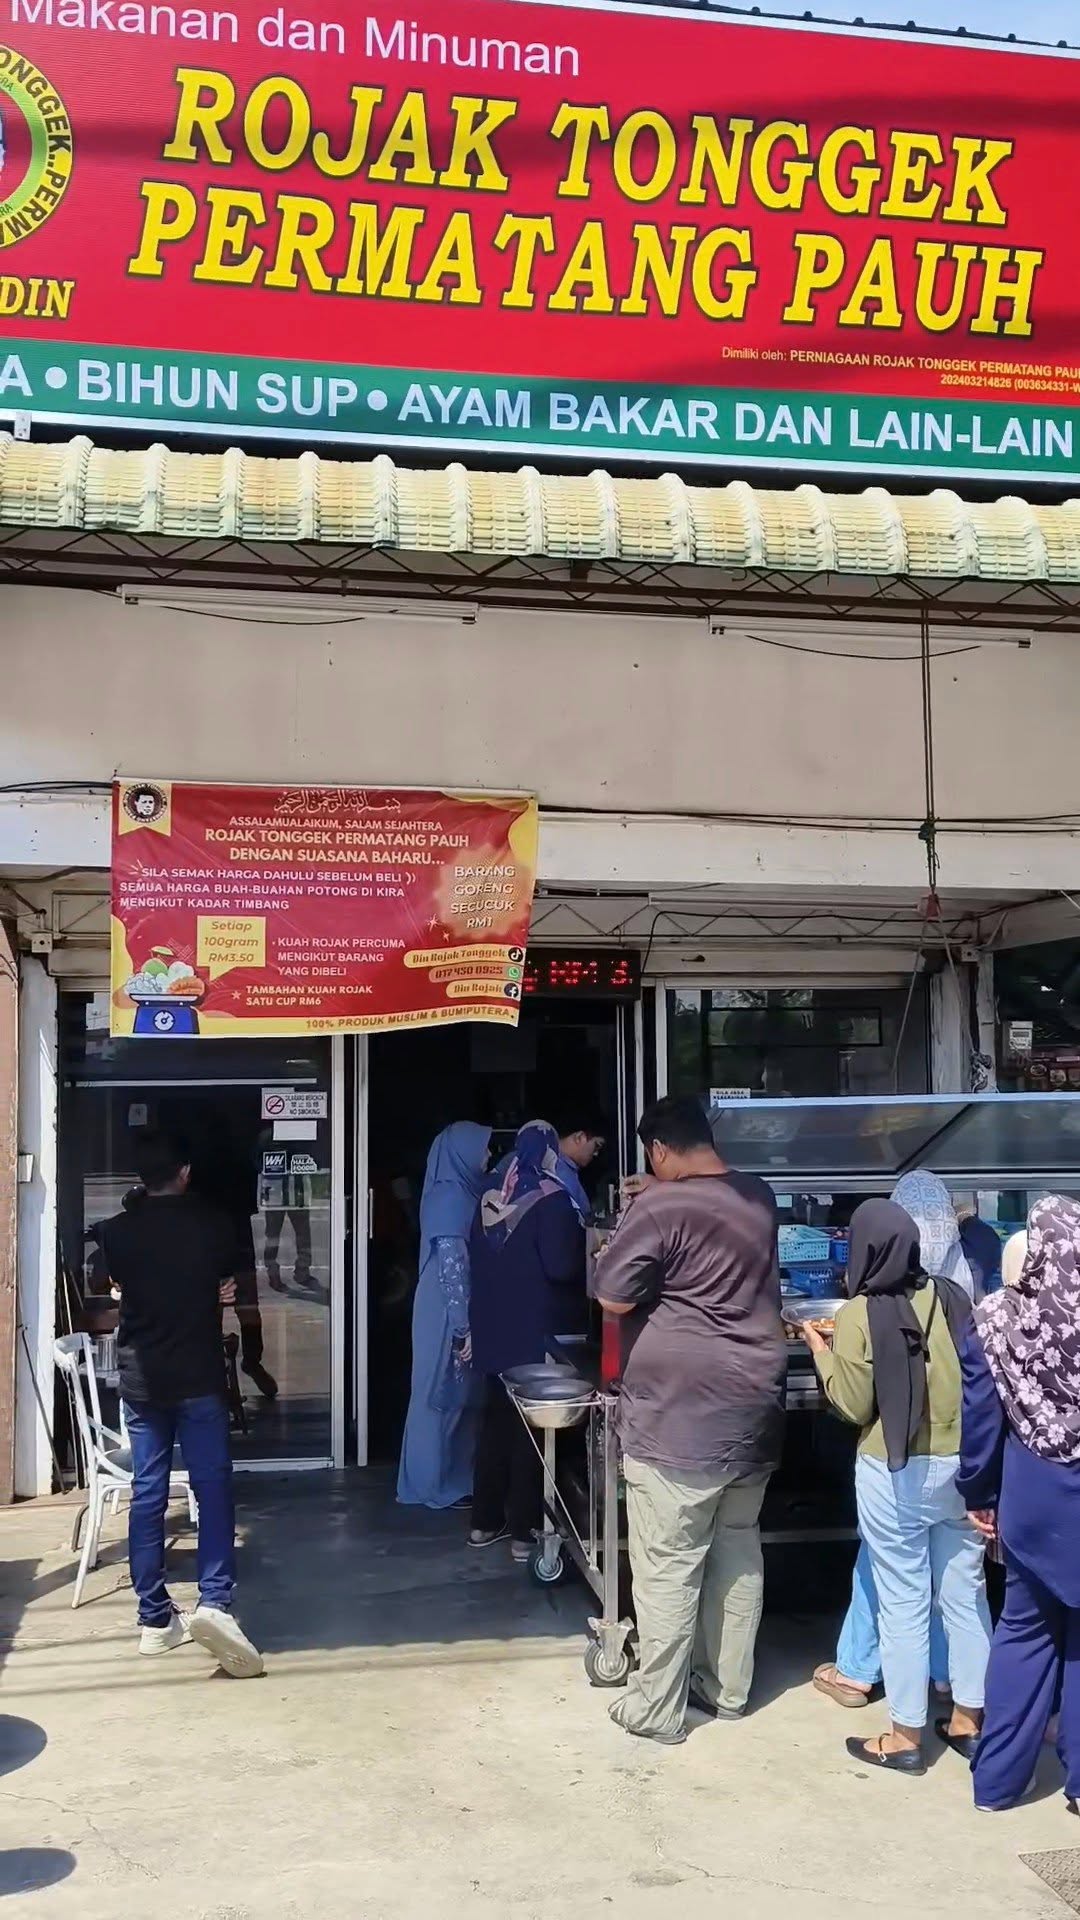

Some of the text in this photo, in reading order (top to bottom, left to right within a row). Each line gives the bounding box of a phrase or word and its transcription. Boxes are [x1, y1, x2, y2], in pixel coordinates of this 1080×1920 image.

[11, 0, 580, 76] Makanan dan Minuman
[163, 67, 1013, 225] ROJAK TONGGEK
[128, 182, 1042, 336] PERMATANG PAUH
[0, 276, 75, 318] DIN
[722, 346, 1080, 379] Dimiliki oleh: PERNIAGAAN ROJAK TONGGEK PERMATANG PAU
[0, 354, 1073, 458] A BIHUN SUP AYAM BAKAR DAN LAIN-LAIN
[229, 816, 442, 831] ASSALAMUALAIKUM, SALAM SEJAHTERA
[205, 829, 469, 847] ROJAK TONGGEK PERMATANG PAUH
[230, 848, 445, 865] DENGAN SUASANA BAHARU...
[142, 868, 401, 882] SILA SEMAK HARGA DAHULU SEBELUM BELI
[454, 865, 515, 877] BARANG
[119, 882, 405, 897] SEMUA HARGA BUAH-BUAHAN POTONG DI KIRA
[454, 882, 514, 895] GORENG
[119, 897, 290, 910] MENGIKUT KADAR TIMBANG
[451, 899, 514, 914] SECUCUK
[211, 921, 253, 932] Setiap
[467, 916, 493, 928] RM1
[204, 936, 259, 948] 100gram
[278, 938, 406, 948] KUAH ROJAK PERCUMA
[208, 952, 254, 962] RM3.50
[278, 952, 384, 962] MENGIKUT BARANG
[278, 967, 347, 976] YANG DIBELI
[246, 985, 373, 994] TAMBAHAN KUAH ROJAK
[246, 997, 321, 1006] SATU CUP RM6
[306, 1006, 510, 1029] 100% PRODUK MUSLIM & BUMIPUTERA
